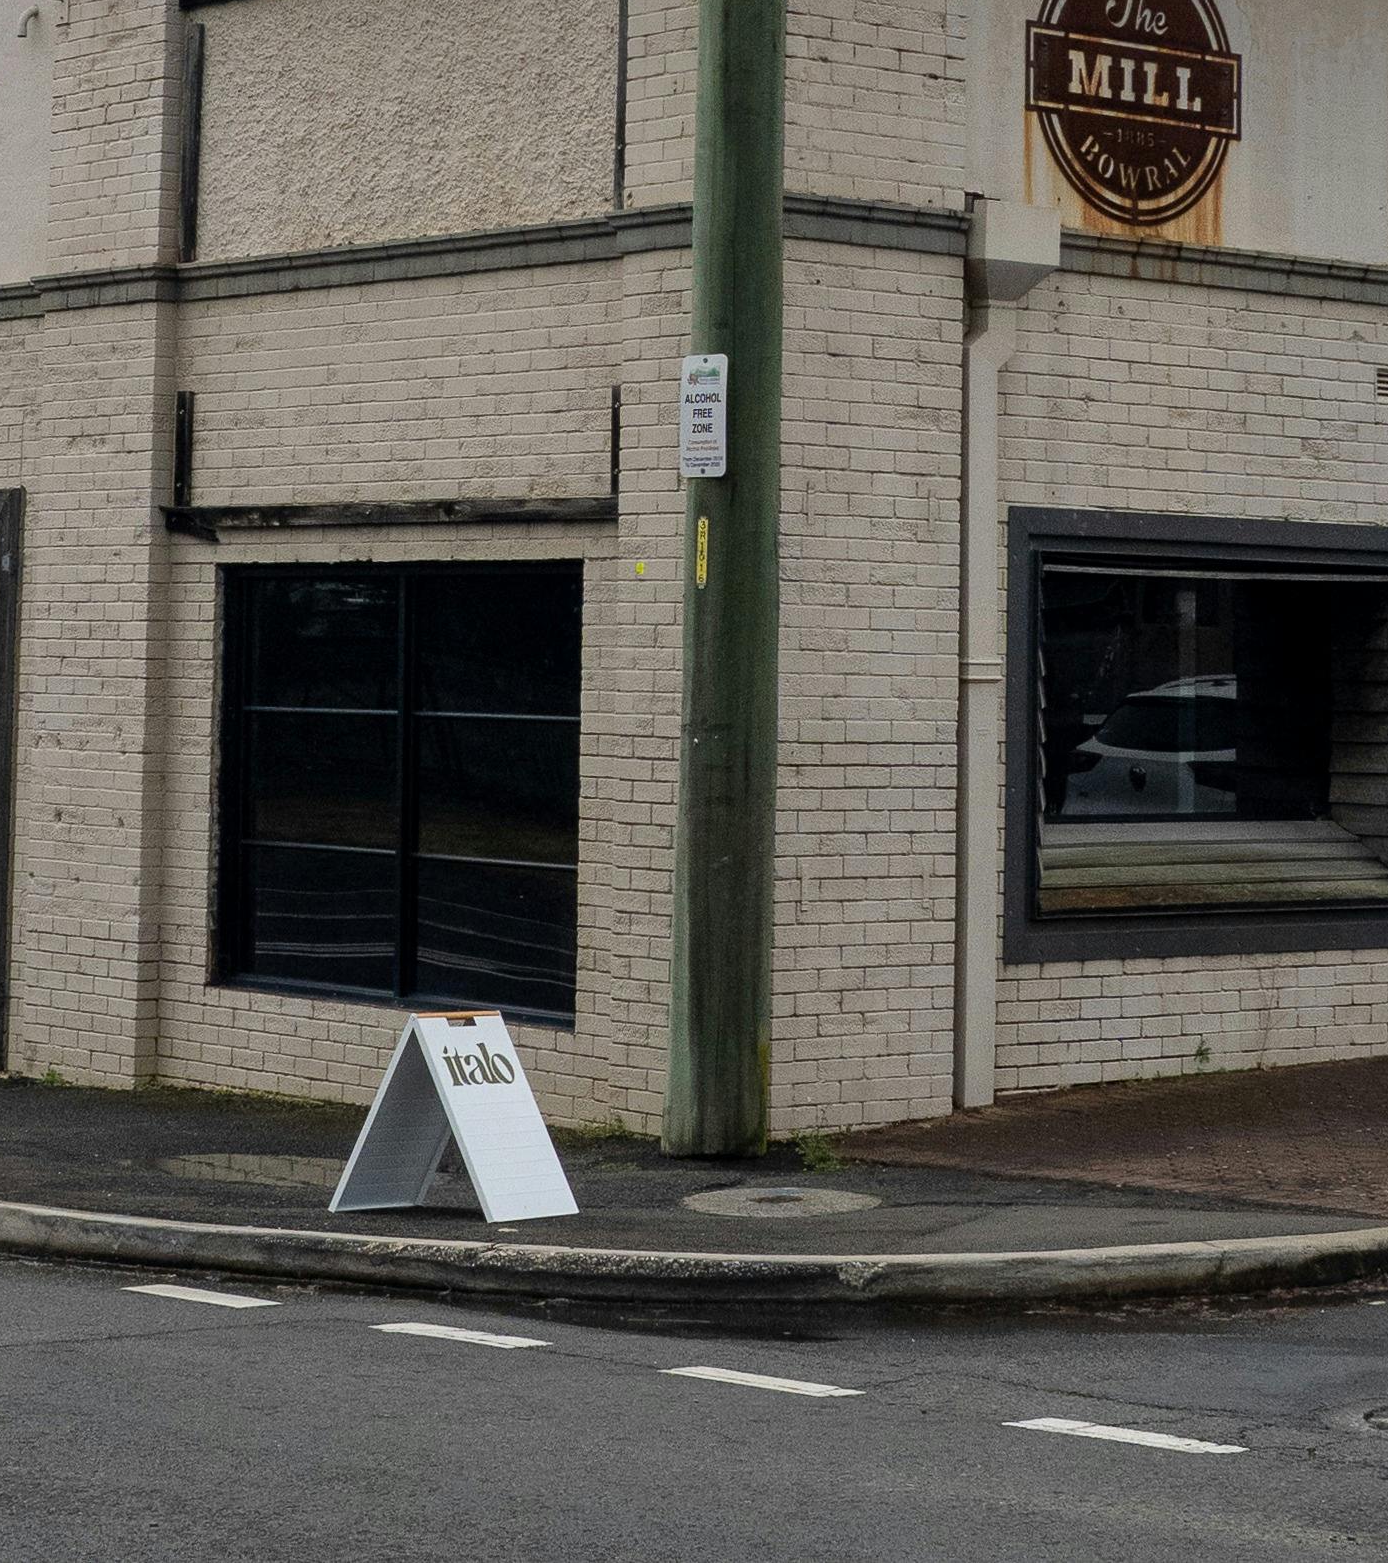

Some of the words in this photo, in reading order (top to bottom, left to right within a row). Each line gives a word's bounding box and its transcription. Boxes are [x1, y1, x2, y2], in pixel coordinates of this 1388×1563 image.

[1068, 49, 1202, 113] MILL
[1080, 135, 1192, 192] BOWRAL
[684, 393, 721, 404] ALCOHOL
[692, 408, 713, 419] FREE
[692, 423, 713, 434] ZONE
